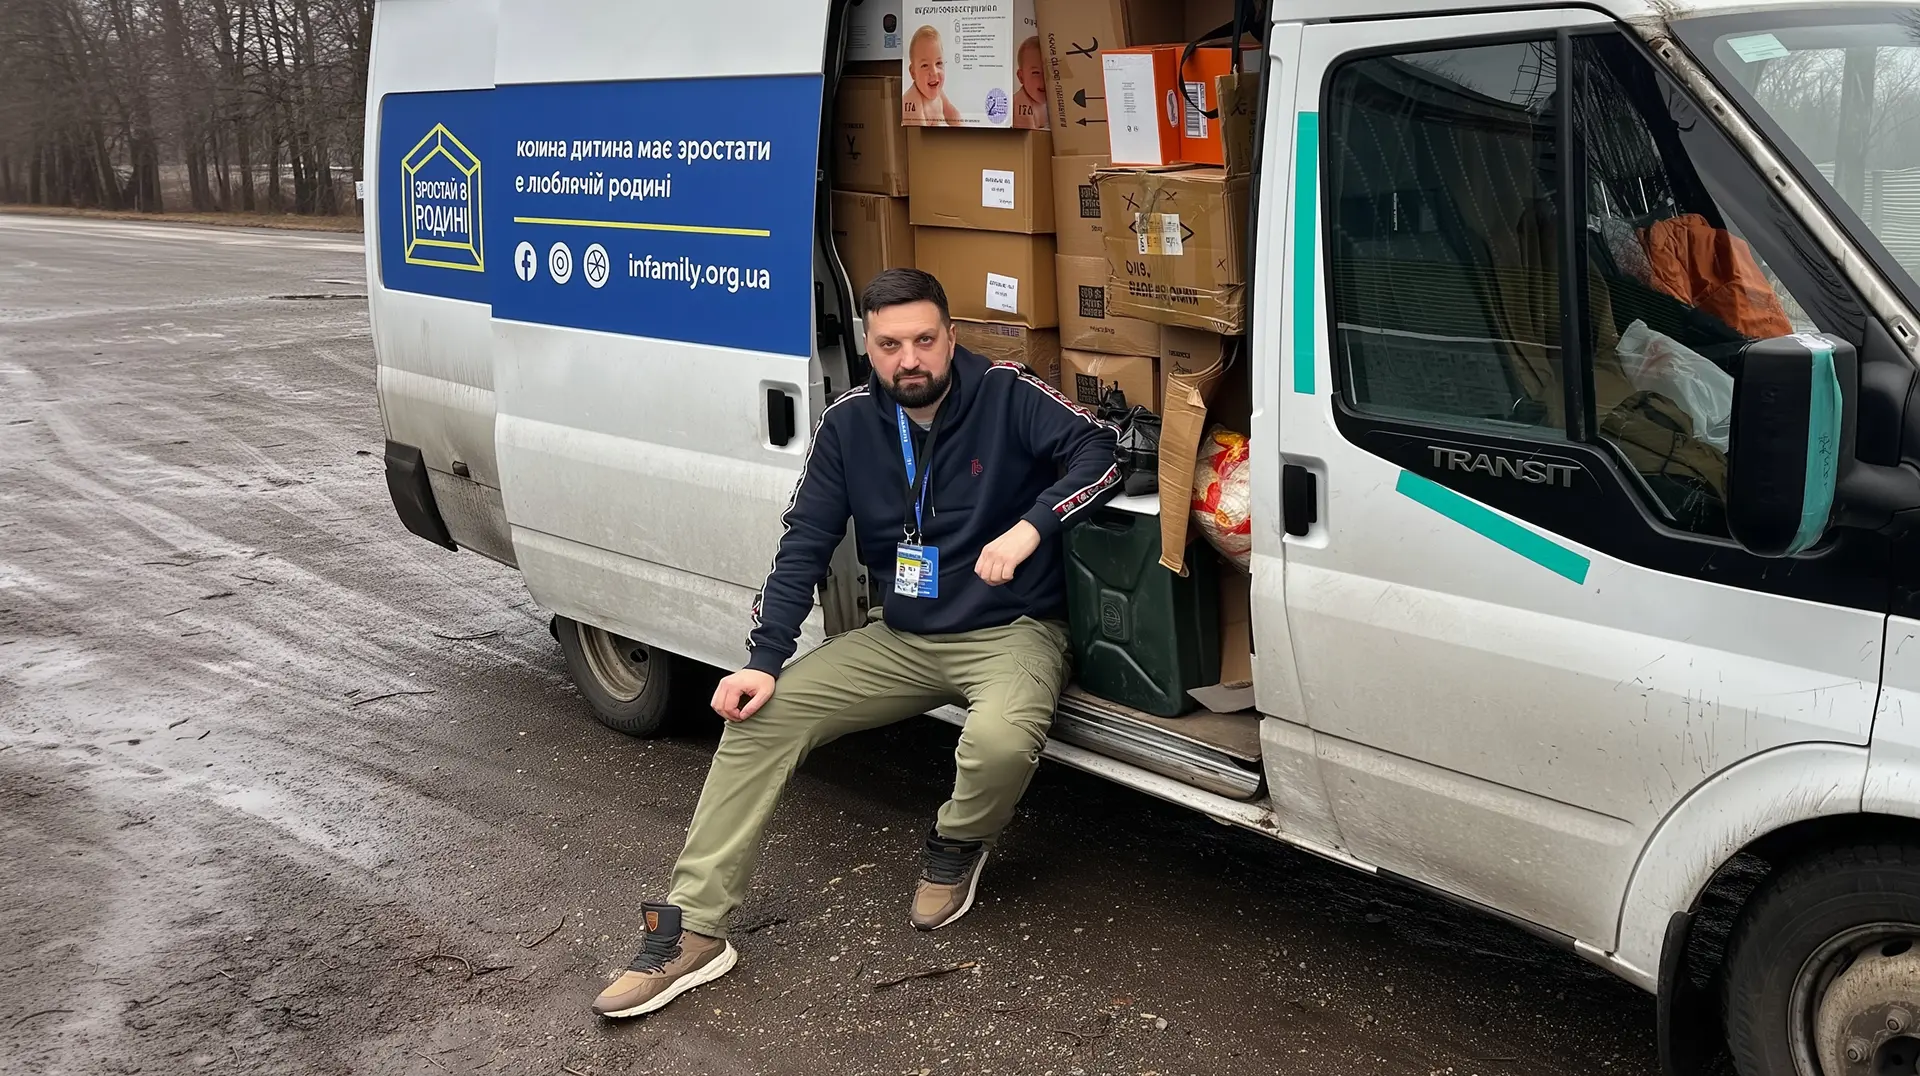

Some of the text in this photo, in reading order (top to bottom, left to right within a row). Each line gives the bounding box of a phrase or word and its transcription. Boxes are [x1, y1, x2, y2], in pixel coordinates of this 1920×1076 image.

[570, 140, 633, 161] дитина
[637, 140, 673, 159] має
[415, 177, 458, 200] ЗРОСТАЙ
[608, 173, 671, 202] родині
[628, 253, 770, 294] infamily.org.ua
[1427, 445, 1581, 488] TRANSIT
